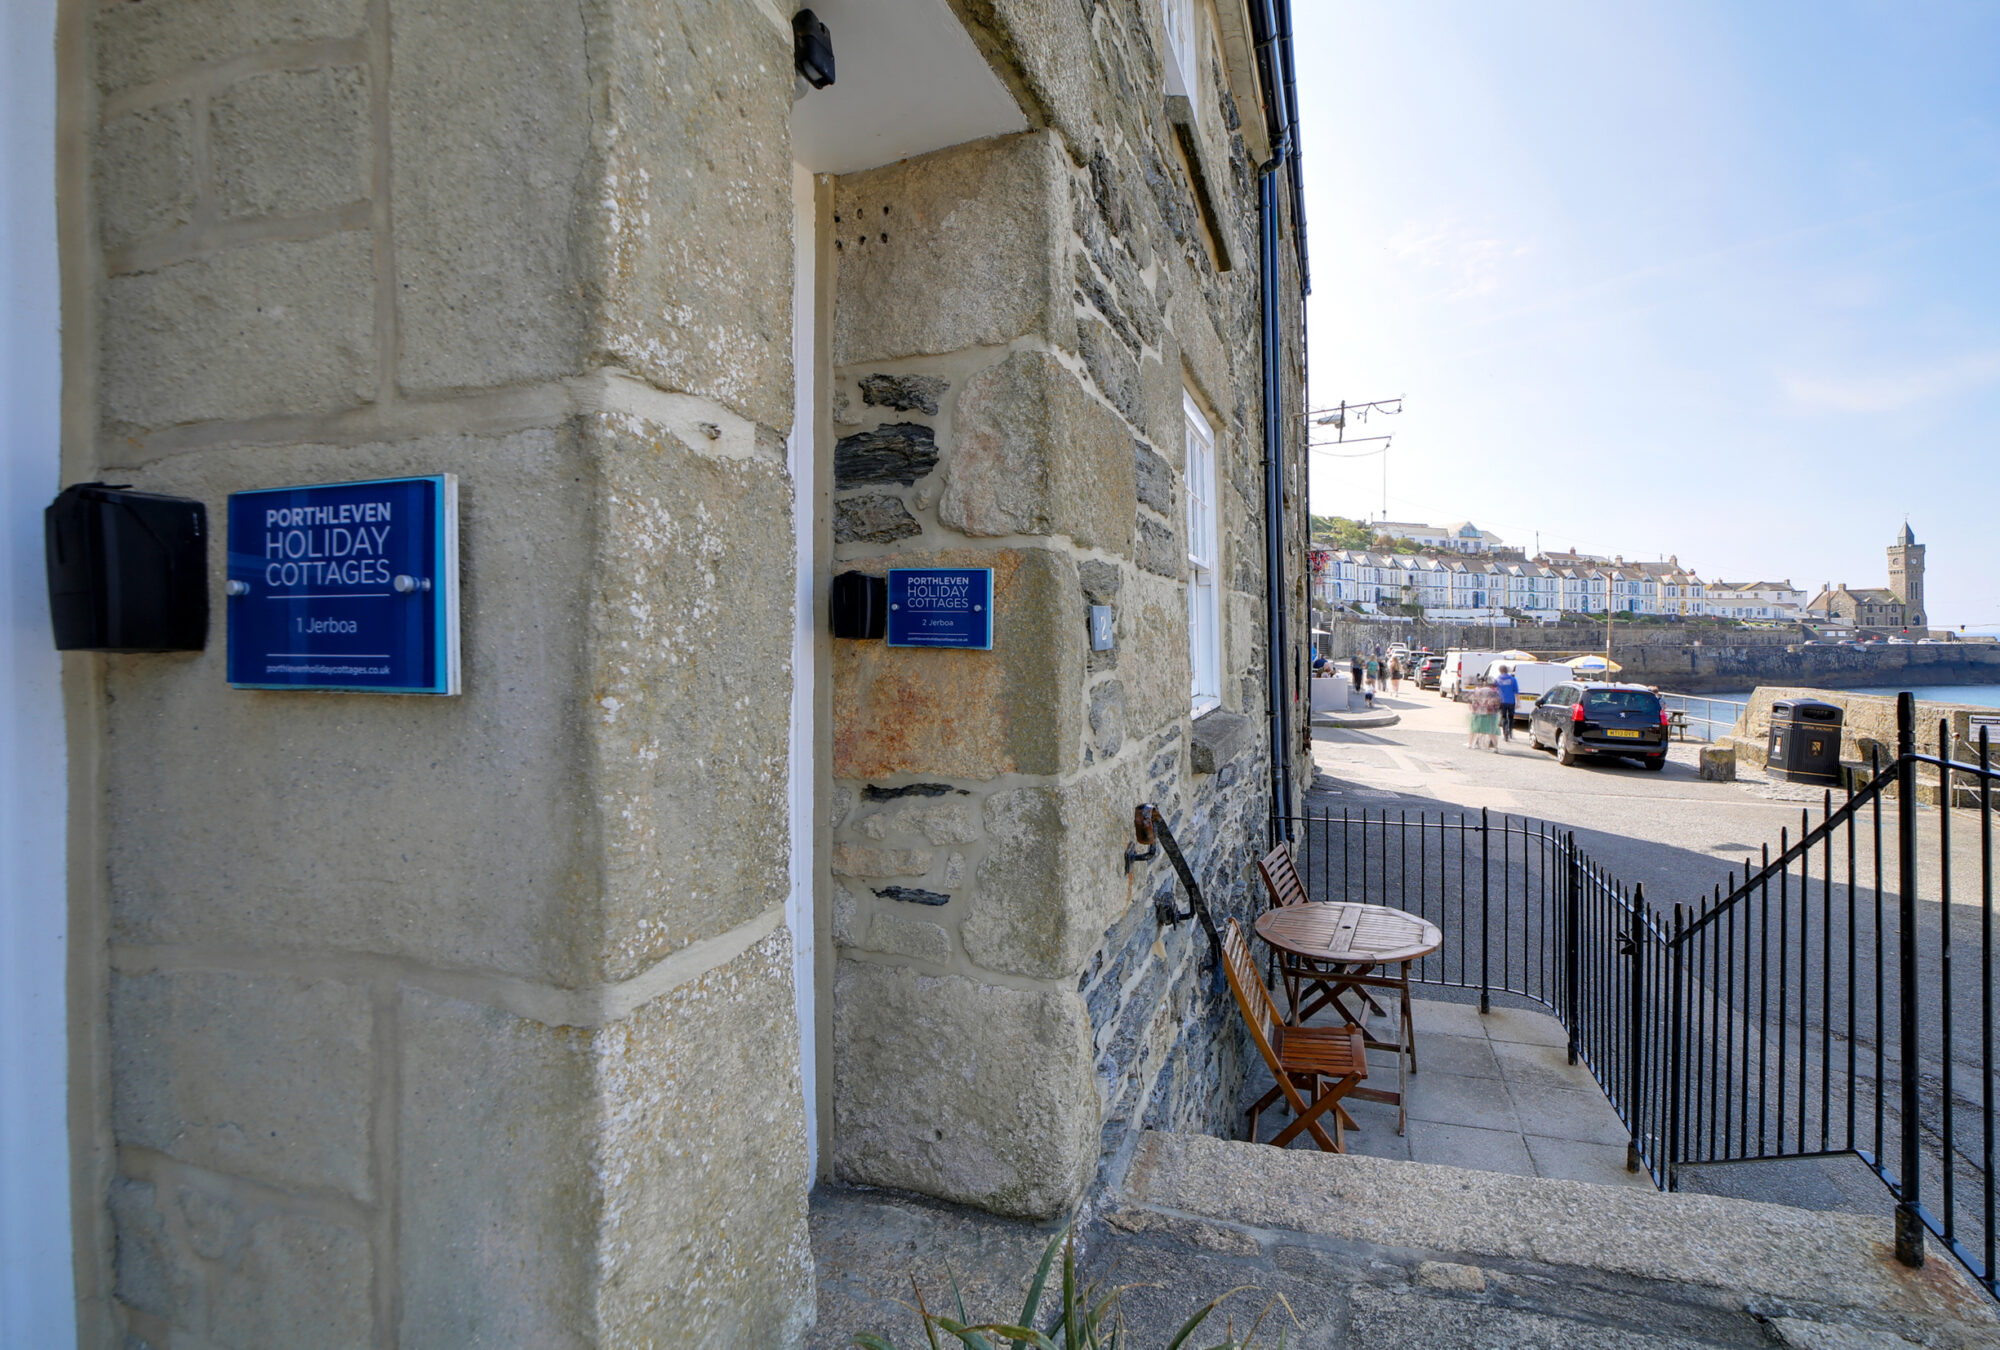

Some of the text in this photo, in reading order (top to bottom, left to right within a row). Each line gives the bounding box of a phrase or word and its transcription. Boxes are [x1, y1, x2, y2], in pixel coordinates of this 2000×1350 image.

[266, 502, 391, 528] PORTHLEVEN
[266, 526, 391, 559] HOLIDAY
[266, 559, 391, 586] COTTAGES
[907, 577, 969, 585] PORTHLEVEN
[907, 586, 968, 597] HOLIDAY
[907, 598, 969, 608] COTTAGES
[296, 617, 358, 633] 1 Jerboa
[921, 619, 954, 627] 2 Jerboa
[1101, 616, 1108, 641] 2
